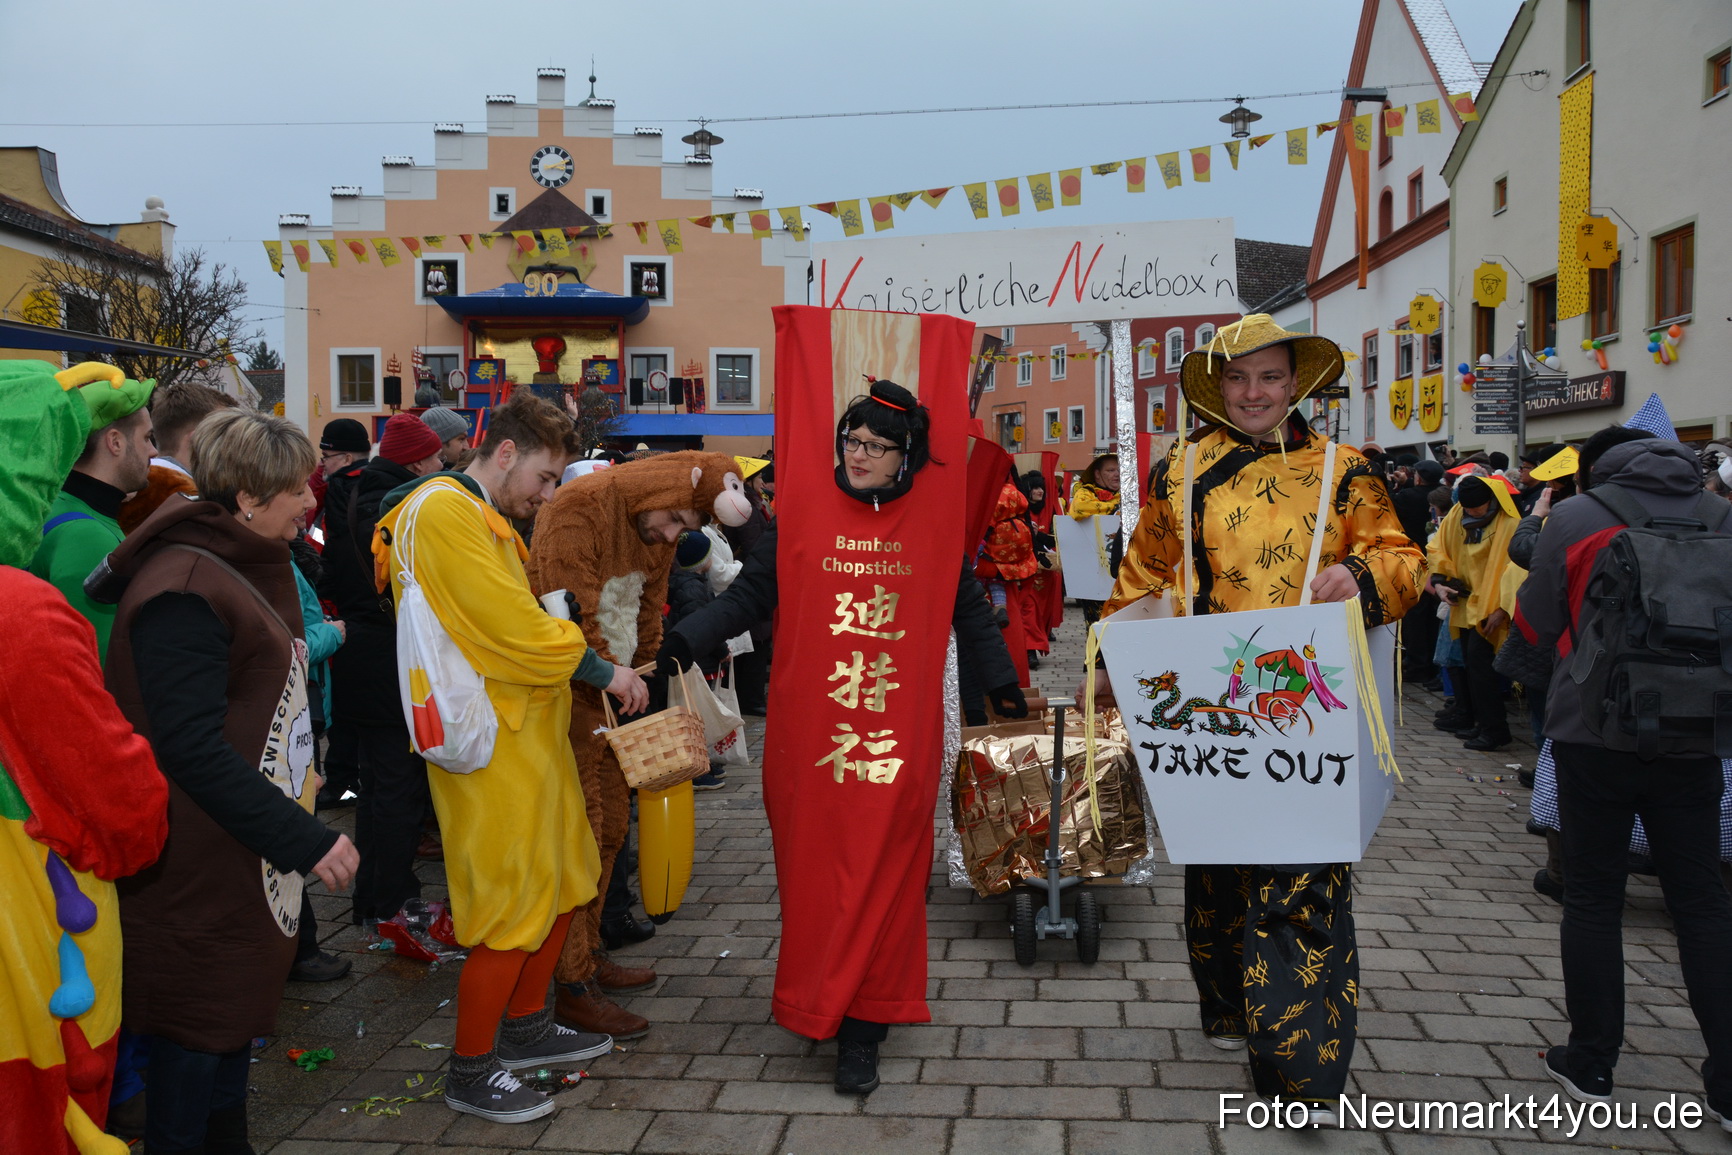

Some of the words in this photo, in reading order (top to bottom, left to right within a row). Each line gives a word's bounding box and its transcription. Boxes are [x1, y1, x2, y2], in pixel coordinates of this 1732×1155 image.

[524, 273, 559, 297] 90
[820, 255, 1049, 314] Kaiserliche
[835, 535, 902, 552] Bamboo
[822, 557, 913, 577] Chopsticks
[1139, 741, 1251, 779] TAKE
[1265, 749, 1355, 786] OUT
